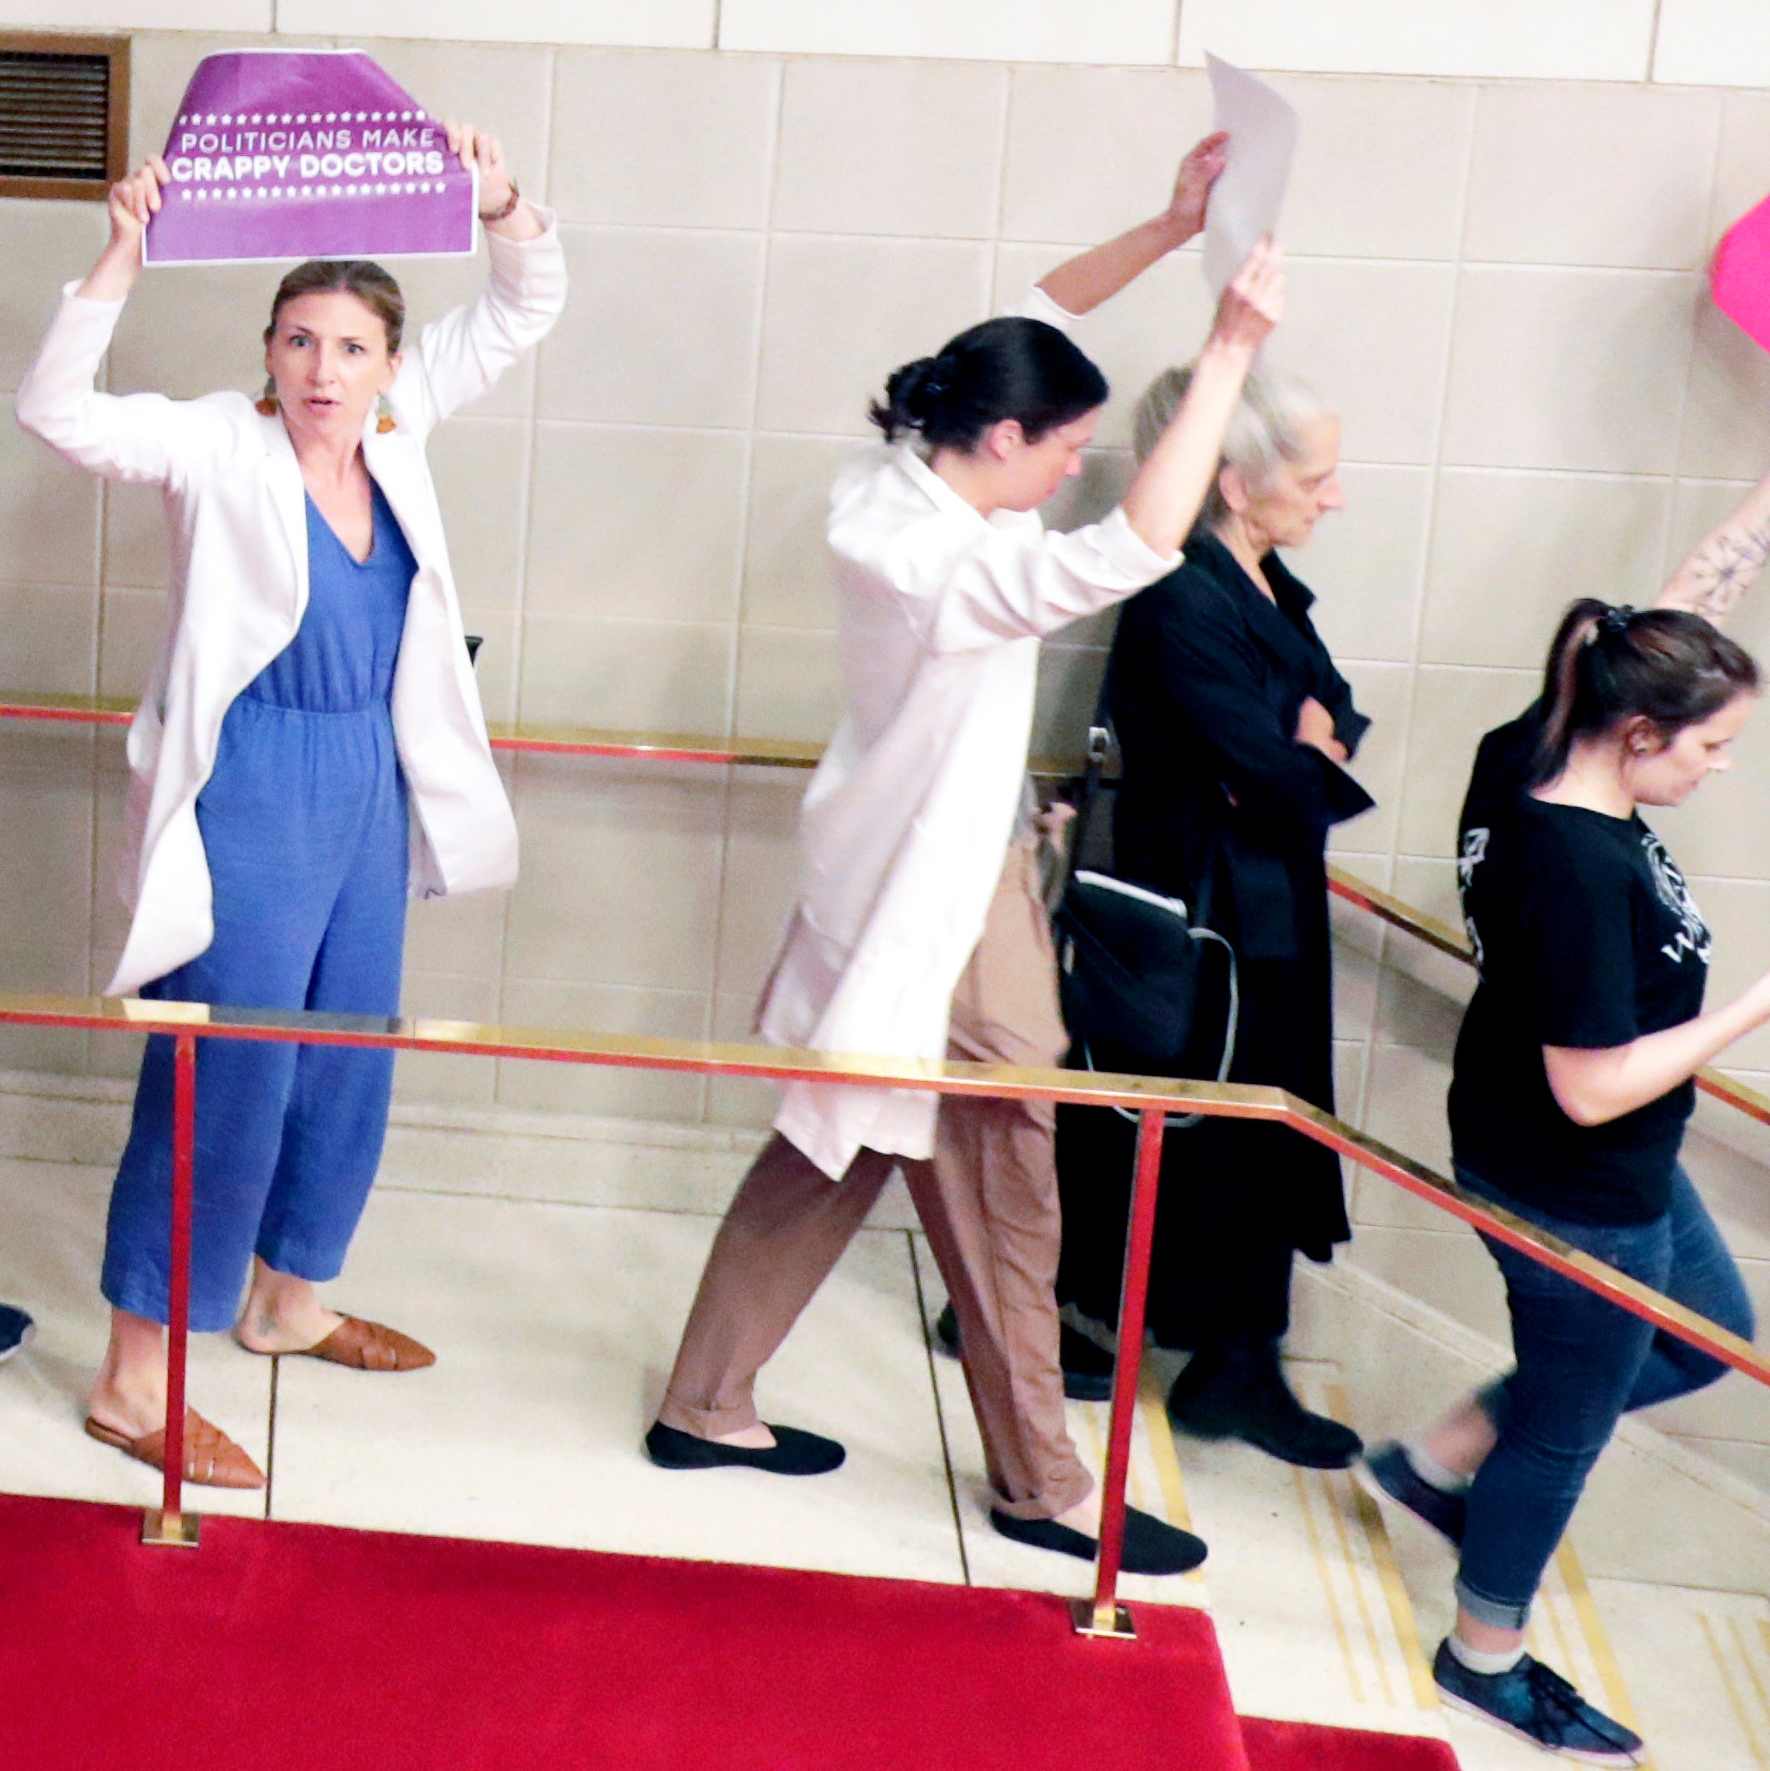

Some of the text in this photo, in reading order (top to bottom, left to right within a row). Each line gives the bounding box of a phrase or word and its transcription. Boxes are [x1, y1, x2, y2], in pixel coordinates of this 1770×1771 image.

[181, 127, 435, 154] POLITICIANS MAKE
[170, 150, 445, 183] CRAPPY DOCTORS
